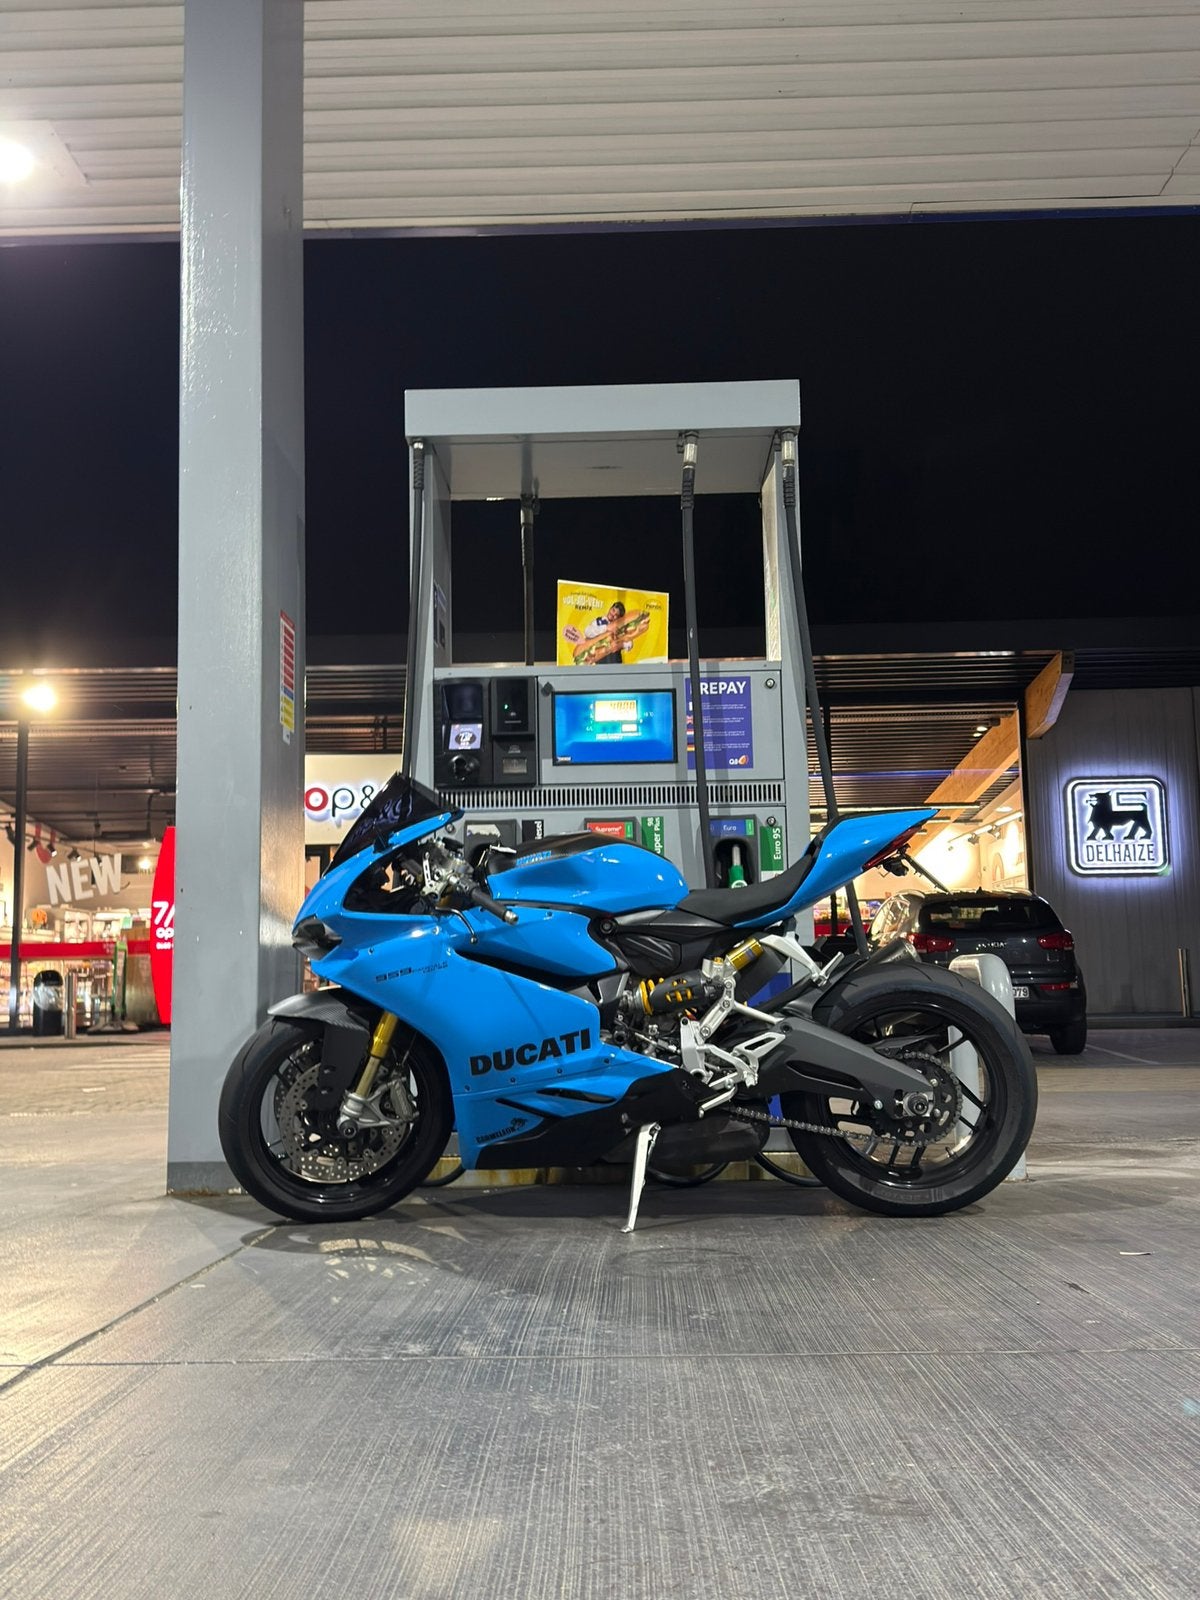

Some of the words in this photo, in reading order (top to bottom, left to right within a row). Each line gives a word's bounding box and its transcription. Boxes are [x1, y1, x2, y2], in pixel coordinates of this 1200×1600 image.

[690, 681, 747, 696] REPAY
[534, 820, 543, 840] iesel
[772, 827, 781, 839] 95
[653, 832, 663, 854] uper
[773, 841, 782, 860] Euro
[1085, 843, 1156, 862] DELHAIZE
[45, 852, 122, 906] NEW
[152, 900, 175, 928] 7/
[155, 926, 175, 941] op
[469, 1027, 591, 1076] DUCATI
